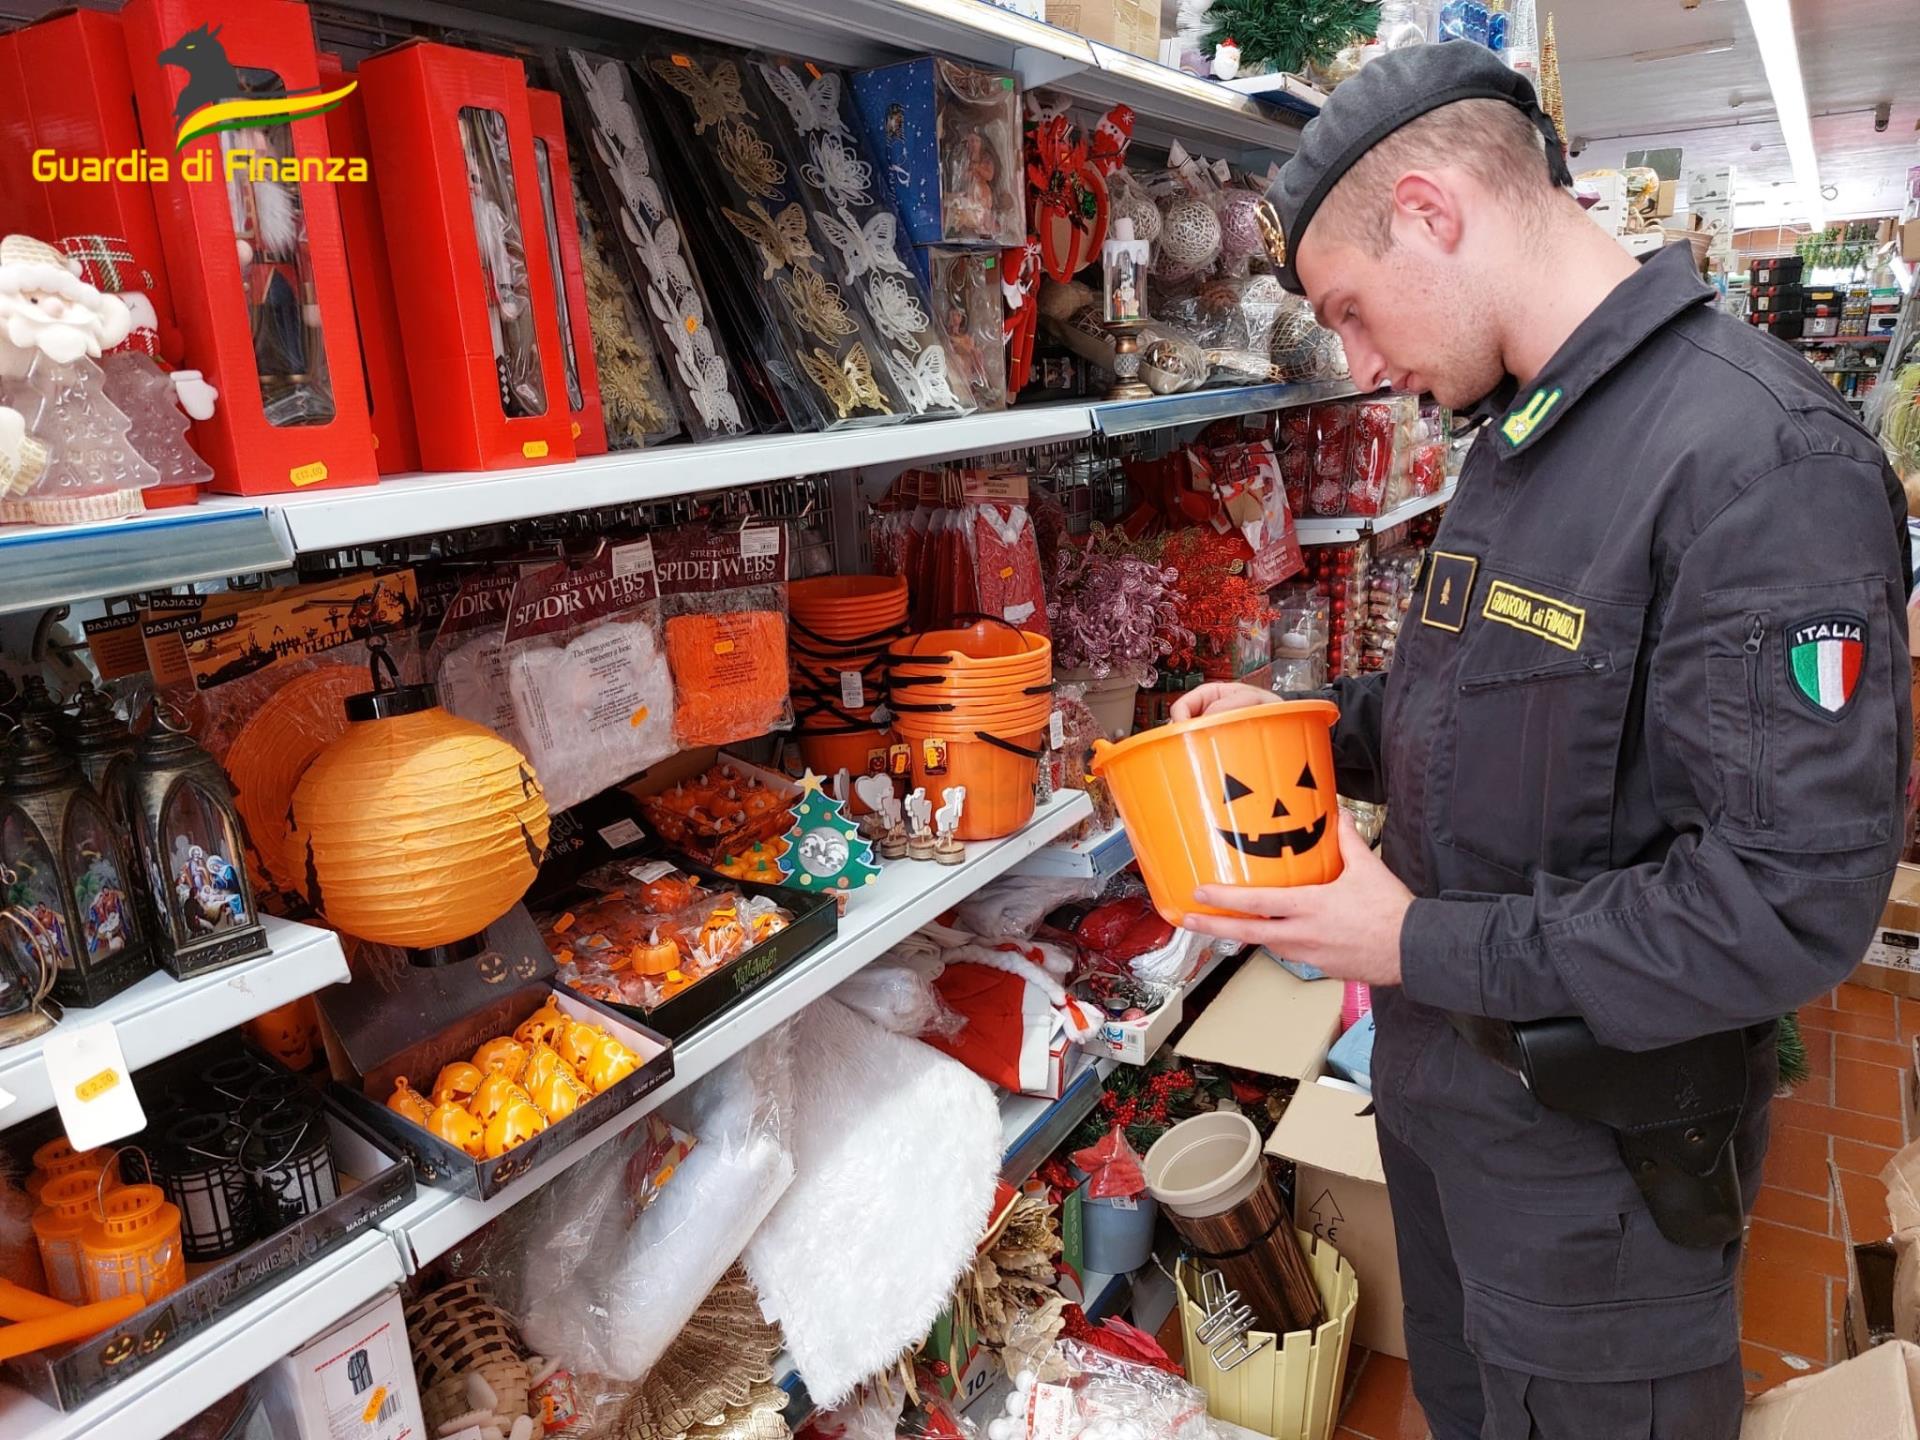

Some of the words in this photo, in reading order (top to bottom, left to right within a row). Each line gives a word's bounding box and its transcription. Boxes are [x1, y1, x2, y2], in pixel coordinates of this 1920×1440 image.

[720, 555, 776, 578] WEBS
[586, 572, 646, 606] WEBS
[87, 614, 136, 633] DAJIAZU
[145, 615, 197, 634] DAJIAZU
[1491, 591, 1532, 623] GUARDIA
[1532, 608, 1545, 627] di
[1543, 608, 1576, 640] FINANZA
[185, 618, 234, 640] DAJIAZU
[1796, 623, 1860, 644] ITALIA
[1896, 956, 1910, 965] 24
[345, 1216, 369, 1233] MADE
[369, 1209, 378, 1219] IN
[378, 1195, 402, 1213] CHINA
[967, 1370, 986, 1396] 10
